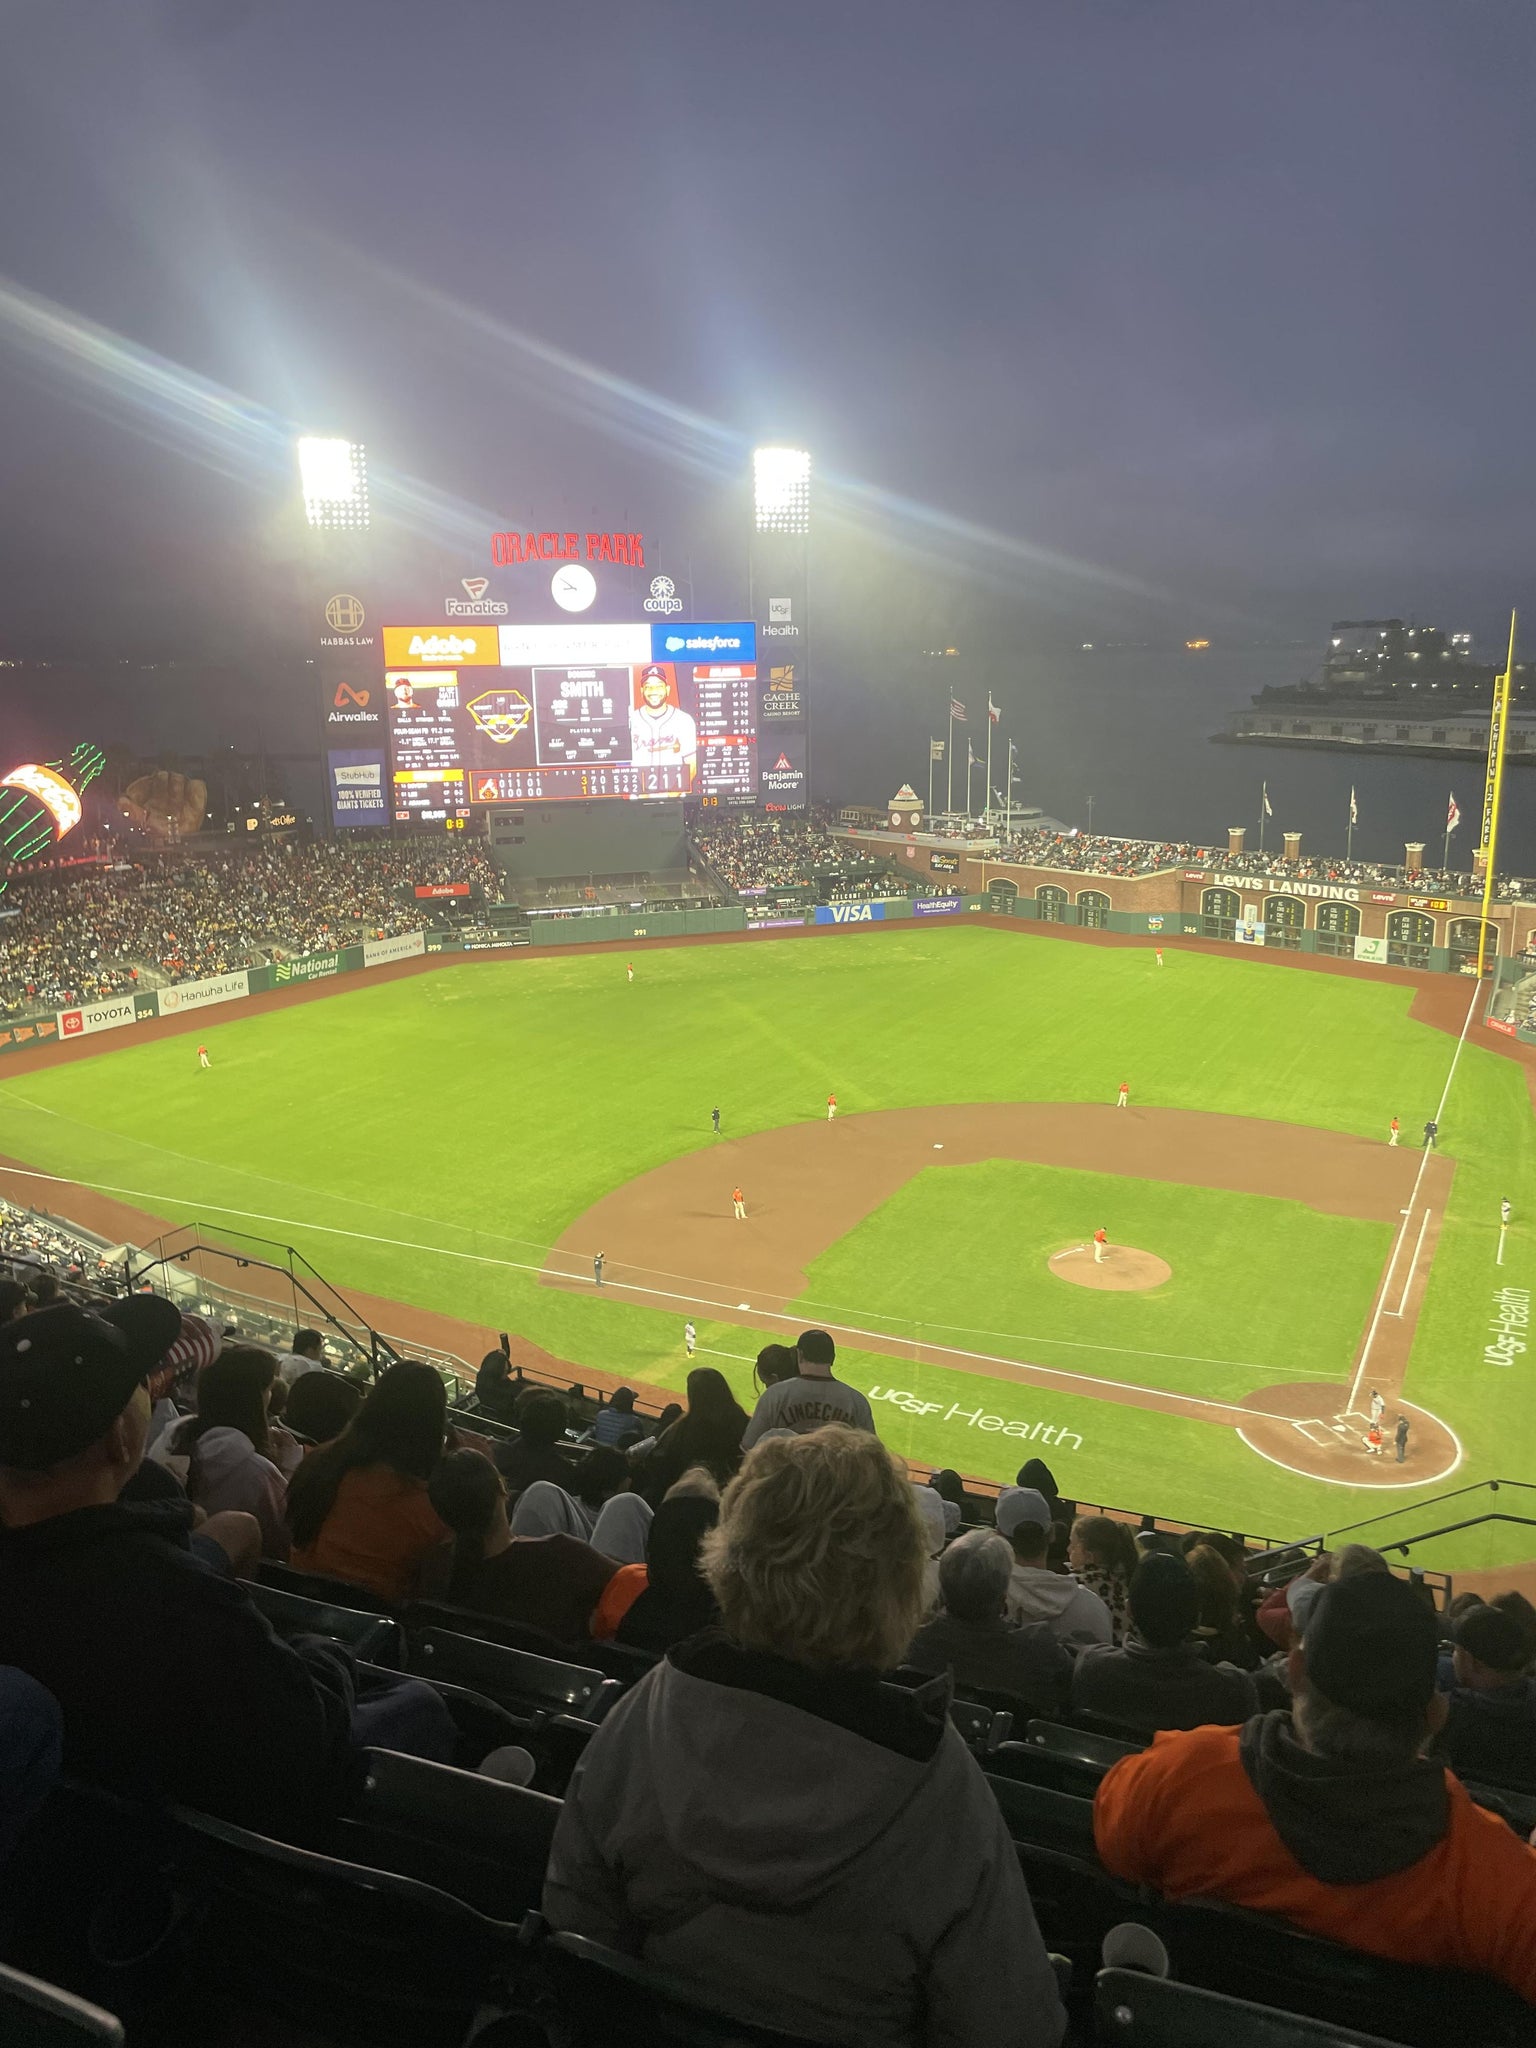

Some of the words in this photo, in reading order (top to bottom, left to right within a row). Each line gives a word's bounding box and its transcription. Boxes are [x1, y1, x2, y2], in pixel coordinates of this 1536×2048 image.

[491, 532, 580, 568] ORACLE
[586, 532, 645, 568] PARK
[447, 600, 507, 616] Fanatics
[645, 598, 682, 614] coupa
[770, 604, 790, 616] UCSF
[762, 625, 798, 636] Health
[320, 638, 354, 646] HABBAS
[356, 637, 373, 645] LAW
[408, 635, 477, 654] Adobe
[686, 637, 740, 650] salesforce
[560, 681, 604, 698] SMITH
[763, 693, 800, 702] CACHE
[764, 702, 799, 710] CREEK
[328, 712, 378, 722] Airwallex
[340, 772, 375, 780] StubHub
[499, 780, 505, 788] 0
[581, 776, 587, 785] 3
[591, 776, 596, 785] 7
[600, 776, 606, 784] 0
[614, 775, 619, 784] 5
[623, 775, 628, 783] 3
[632, 775, 637, 783] 2
[648, 775, 657, 790] 2
[663, 774, 668, 789] 1
[676, 774, 681, 788] 1
[762, 770, 803, 782] Benjamin
[508, 789, 514, 797] 0
[516, 789, 522, 797] 0
[528, 788, 534, 796] 0
[536, 788, 542, 796] 0
[592, 786, 597, 794] 5
[614, 785, 619, 793] 5
[632, 784, 638, 792] 2
[768, 781, 798, 790] Moore
[338, 790, 354, 800] 100%
[355, 789, 381, 799] VERIFIED
[336, 800, 358, 810] GIANTS
[359, 799, 384, 808] TICKETS
[766, 802, 787, 811] Coors
[1484, 808, 1492, 844] FARE
[940, 856, 958, 865] Sports
[1269, 880, 1359, 902] LANDING
[917, 901, 958, 909] HealthEquity
[829, 904, 873, 922] VISA
[366, 952, 380, 960] BANK
[389, 945, 412, 955] AMERICA
[427, 944, 441, 952] 399
[291, 954, 338, 977] National
[1460, 965, 1477, 975] 309
[319, 968, 337, 978] Rental
[181, 988, 223, 1004] Hanwha
[224, 980, 244, 993] Life
[86, 1006, 132, 1024] TOYOTA
[137, 1009, 153, 1019] 354
[1490, 1021, 1512, 1032] ORACLE
[1488, 1288, 1531, 1336] Health
[1483, 1334, 1527, 1366] UCSF
[868, 1386, 943, 1416] UCSF
[944, 1402, 1083, 1450] Health
